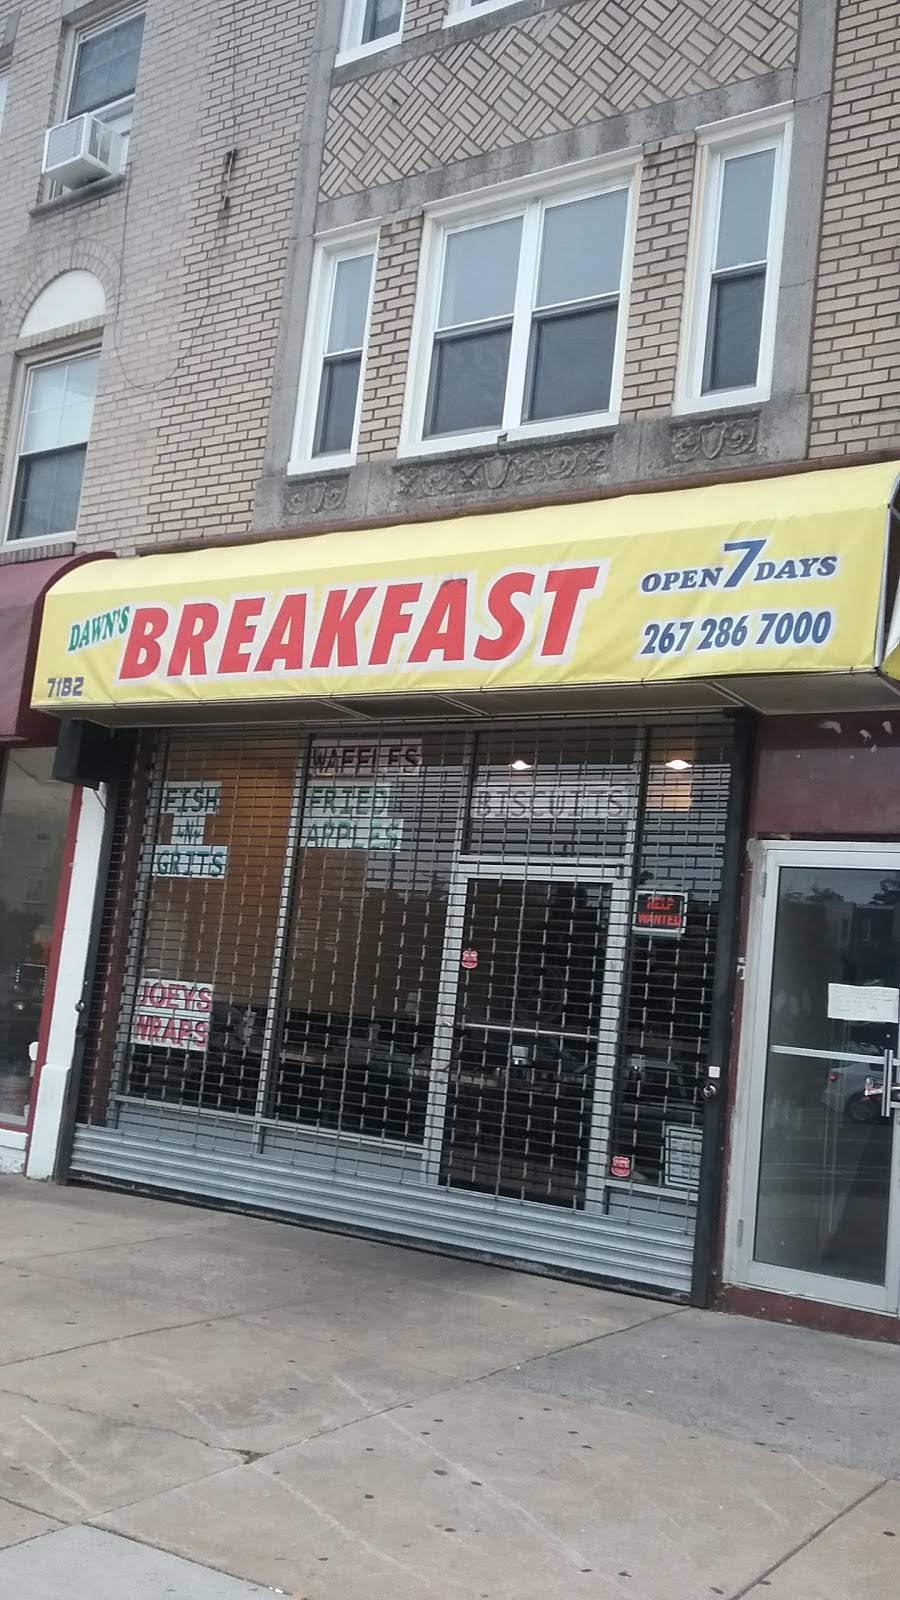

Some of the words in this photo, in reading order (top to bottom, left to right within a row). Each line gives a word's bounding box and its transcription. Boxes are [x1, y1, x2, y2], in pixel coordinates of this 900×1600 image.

[641, 567, 724, 592] OPEN
[723, 539, 767, 588] 7
[753, 556, 838, 581] DAYS
[68, 606, 130, 652] DAWN'S
[118, 566, 600, 680] BREAKFAST
[640, 621, 694, 655] 267
[696, 615, 750, 650] 286
[755, 611, 832, 645] 7000
[47, 677, 84, 698] 7182
[311, 746, 419, 773] WAFFLES
[164, 788, 218, 812] FISH
[309, 787, 388, 814] FRIED
[477, 789, 624, 817] BISCUITS
[305, 821, 399, 849] APPLES
[158, 850, 224, 877] GRITS
[637, 912, 683, 927] WANTED
[139, 981, 213, 1013] JOEYS
[135, 1014, 209, 1048] WRAPS
